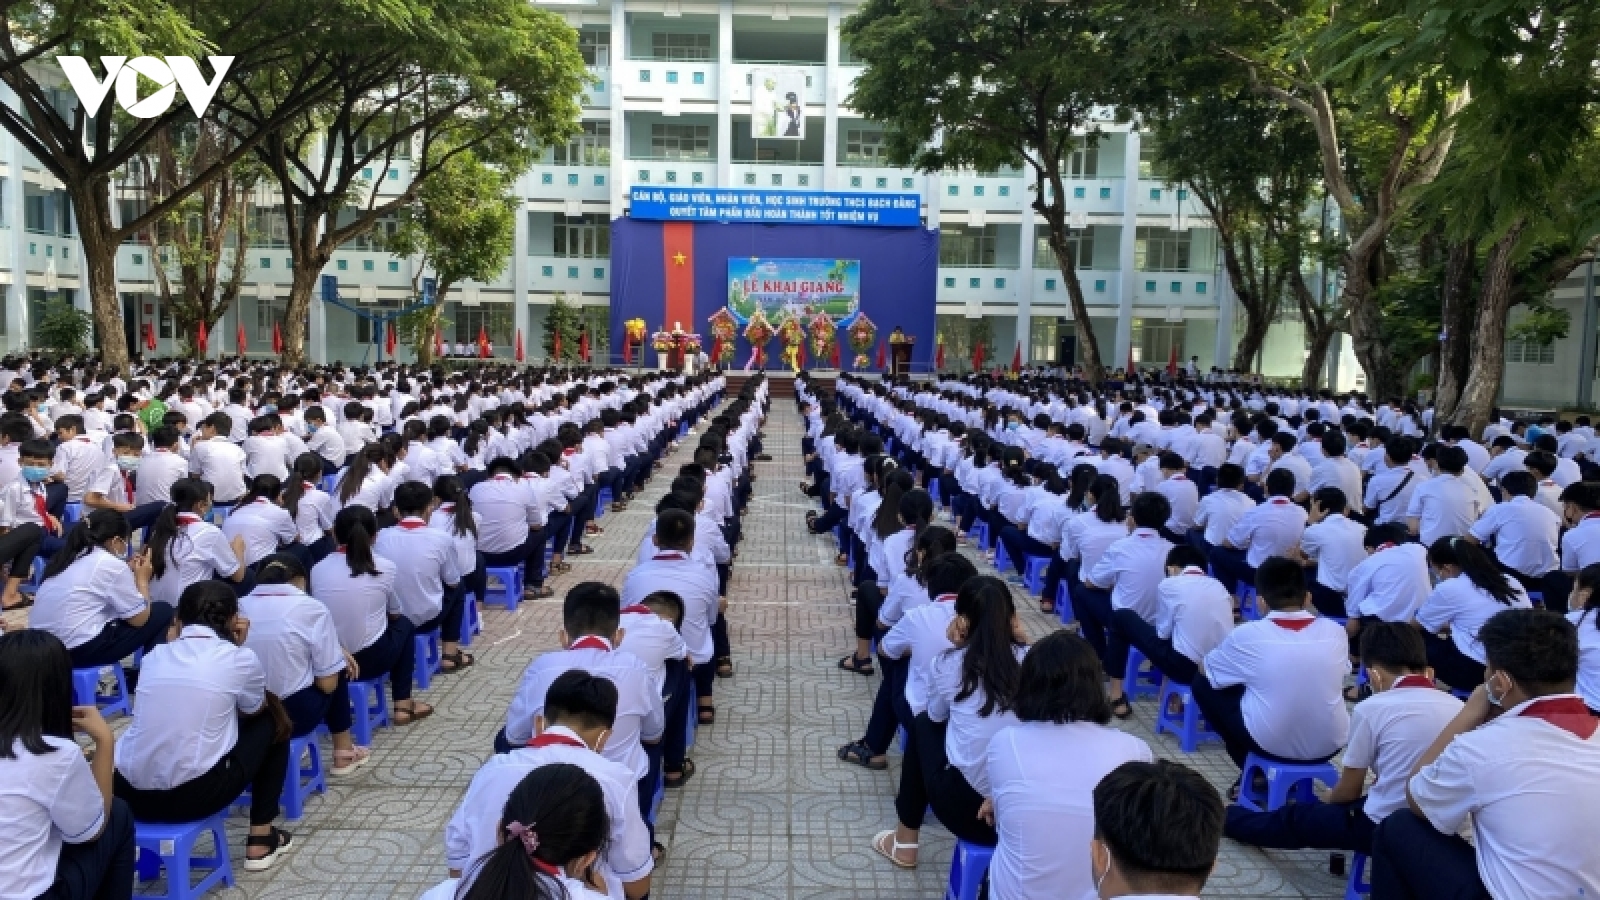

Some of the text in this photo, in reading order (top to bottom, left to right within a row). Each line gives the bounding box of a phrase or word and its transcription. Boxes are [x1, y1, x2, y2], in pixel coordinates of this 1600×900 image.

[785, 195, 807, 207] SINH
[844, 197, 866, 208] THCS
[763, 281, 797, 293] KHAI
